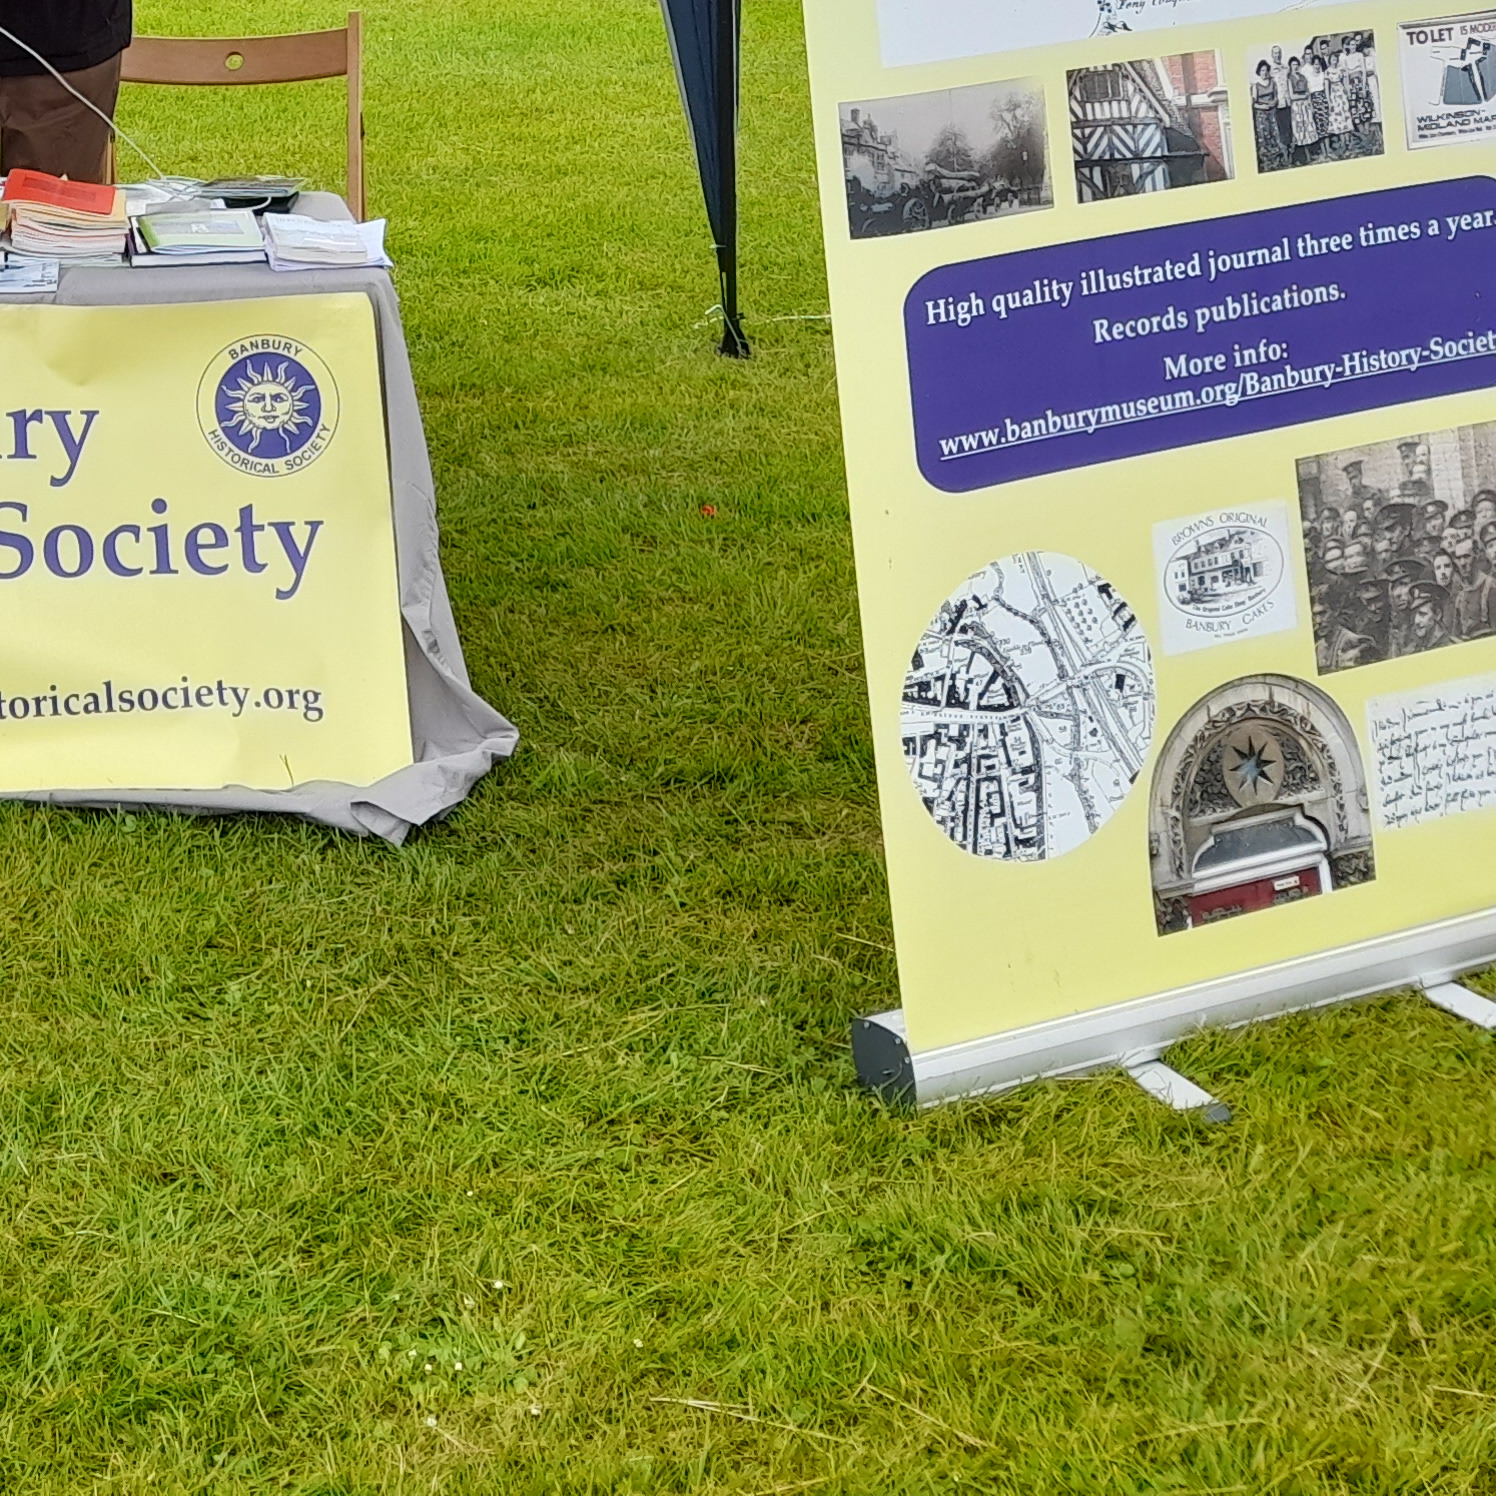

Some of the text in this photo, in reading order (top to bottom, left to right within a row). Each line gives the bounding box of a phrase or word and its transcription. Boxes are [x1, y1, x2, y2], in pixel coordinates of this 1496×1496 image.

[1406, 30, 1429, 45] TO
[1431, 27, 1454, 43] LET
[925, 292, 985, 327] High
[992, 279, 1074, 318] quality
[1080, 252, 1201, 295] illustrated
[1208, 238, 1291, 281] journal
[1297, 232, 1353, 258] three
[1359, 221, 1420, 247] times
[1427, 220, 1439, 236] a
[1093, 283, 1346, 343] Records publications.
[227, 339, 303, 360] BANBURY
[1163, 339, 1288, 381] More info:
[208, 424, 331, 474] HISTORICAL SOCIETY
[1185, 618, 1231, 633] BANBURY
